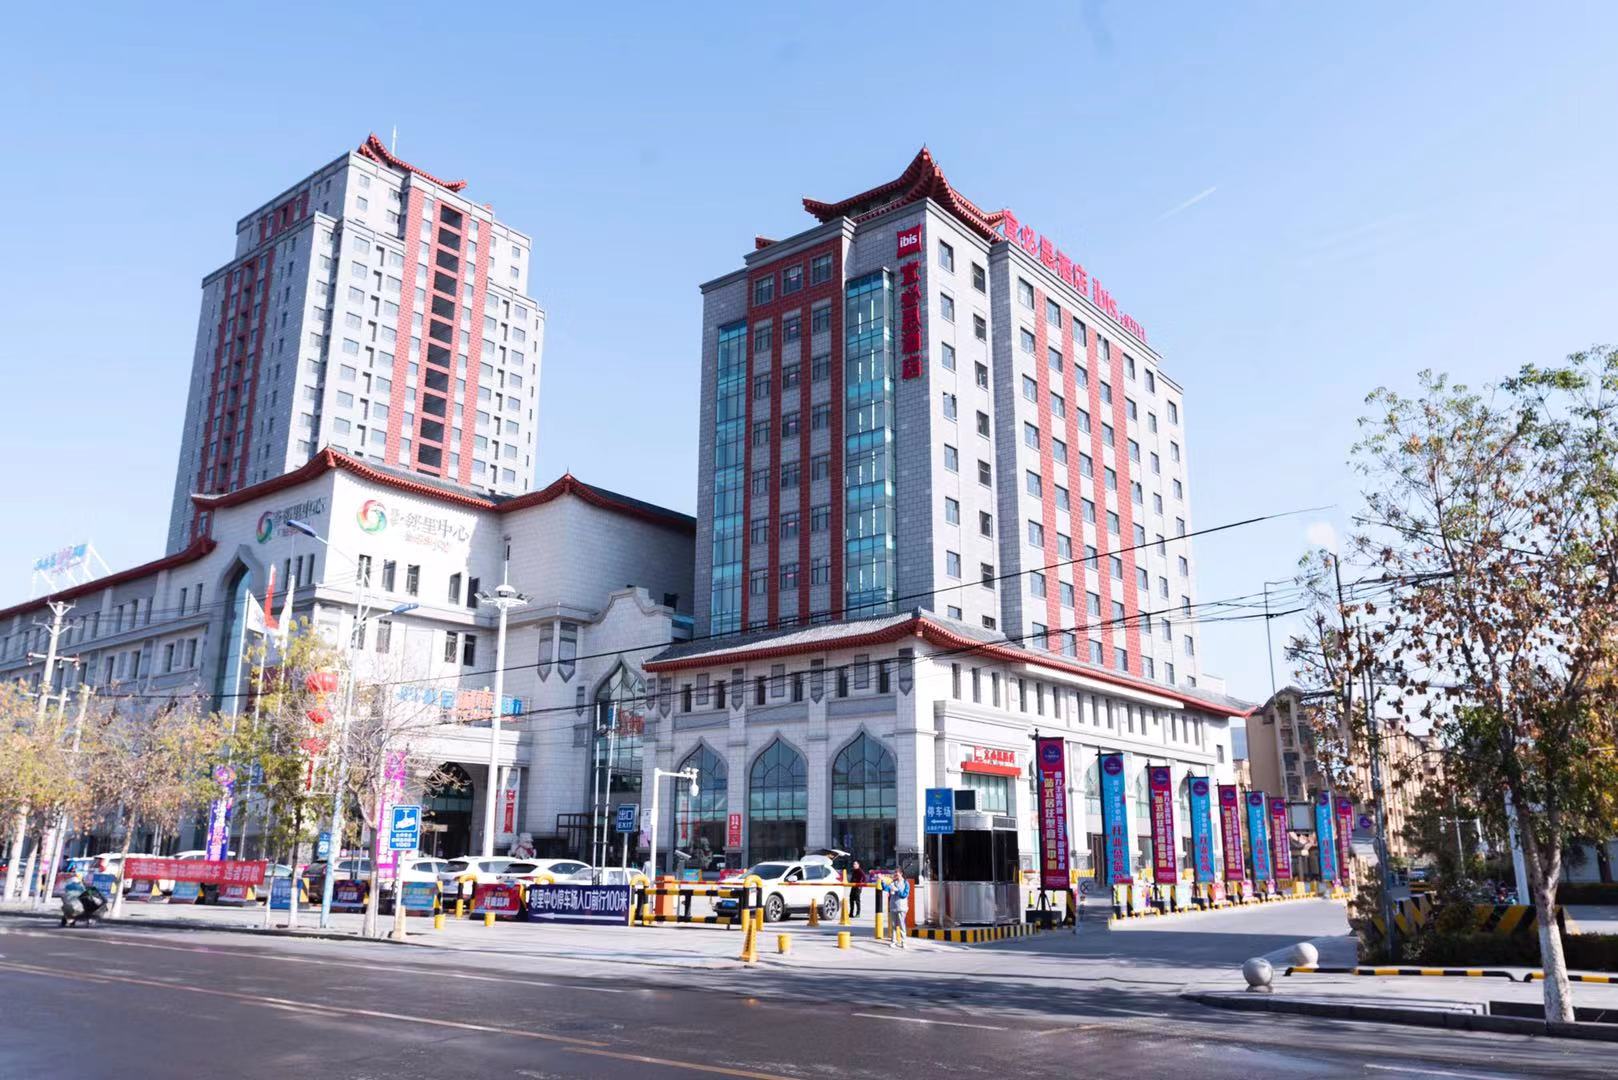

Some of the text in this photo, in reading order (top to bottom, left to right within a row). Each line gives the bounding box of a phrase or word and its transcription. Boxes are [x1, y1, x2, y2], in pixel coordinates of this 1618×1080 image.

[900, 235, 917, 248] ibis
[618, 808, 633, 821] 出口
[927, 806, 952, 818] 停车场
[531, 888, 628, 912] 邻里中心停车场入口前行100米
